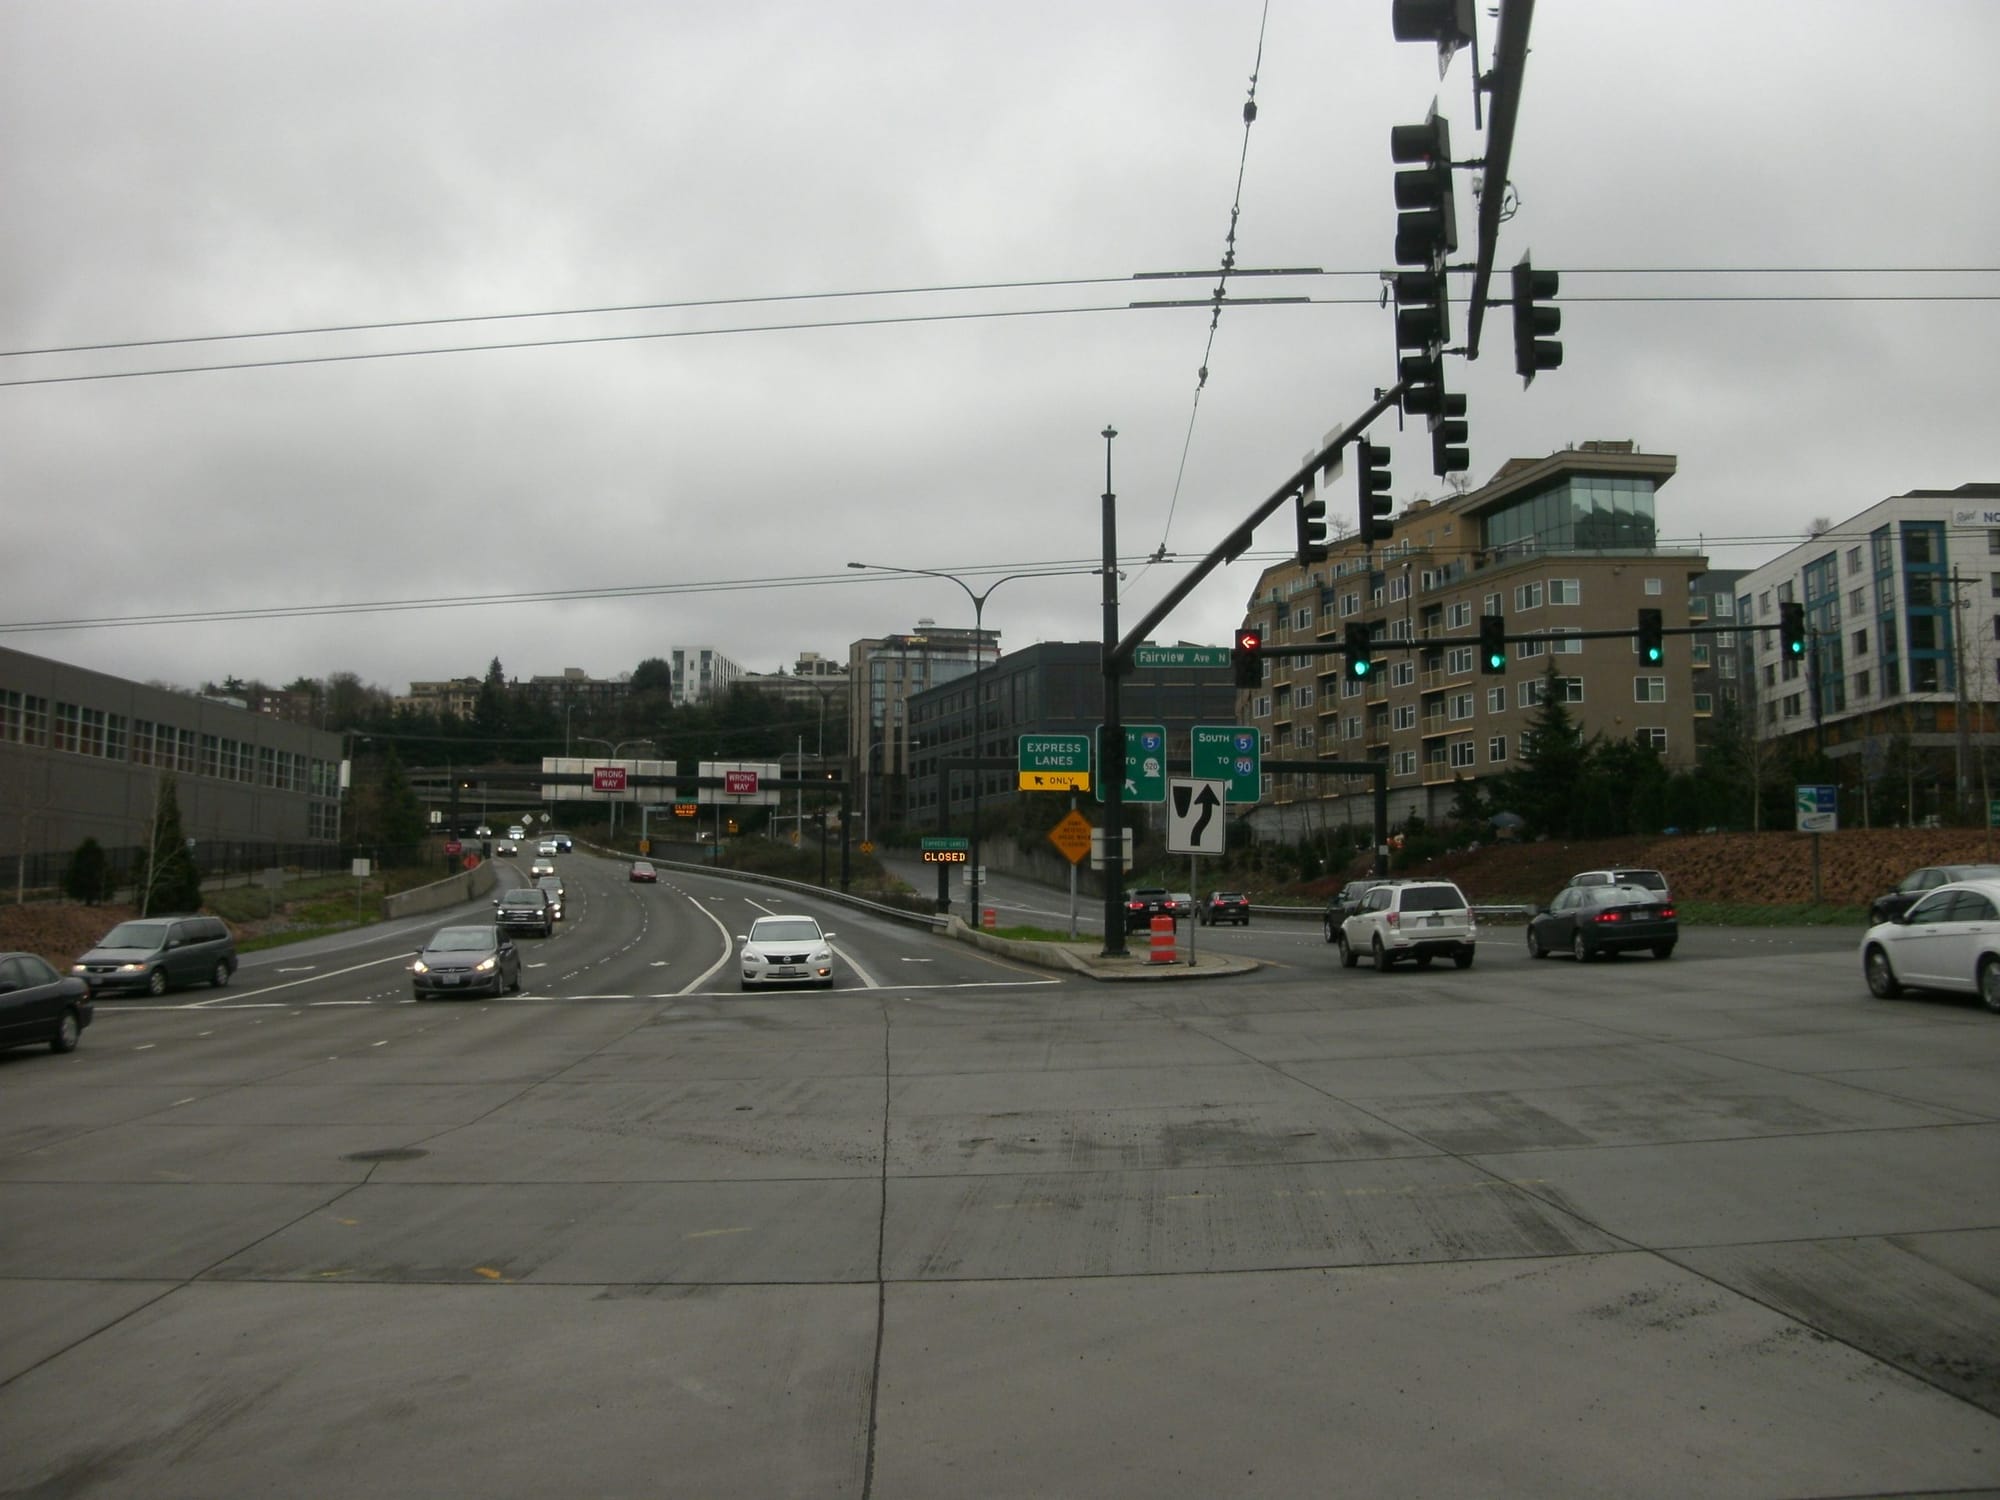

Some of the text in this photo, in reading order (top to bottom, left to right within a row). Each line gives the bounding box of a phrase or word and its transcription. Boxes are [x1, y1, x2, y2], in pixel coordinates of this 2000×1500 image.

[1140, 651, 1226, 663] Fairview Ave N
[1147, 737, 1155, 747] 5
[1239, 738, 1247, 749] 5
[1027, 743, 1081, 753] EXPRESS
[1035, 756, 1073, 766] LANES
[1216, 756, 1230, 765] TO
[1146, 762, 1157, 770] 520
[1236, 761, 1251, 772] 90
[596, 770, 623, 778] WRONG
[729, 773, 755, 782] WRONG
[601, 779, 618, 787] WAY
[1049, 776, 1074, 785] ONLY
[733, 783, 750, 791] WAY
[924, 852, 966, 862] CLOSED
